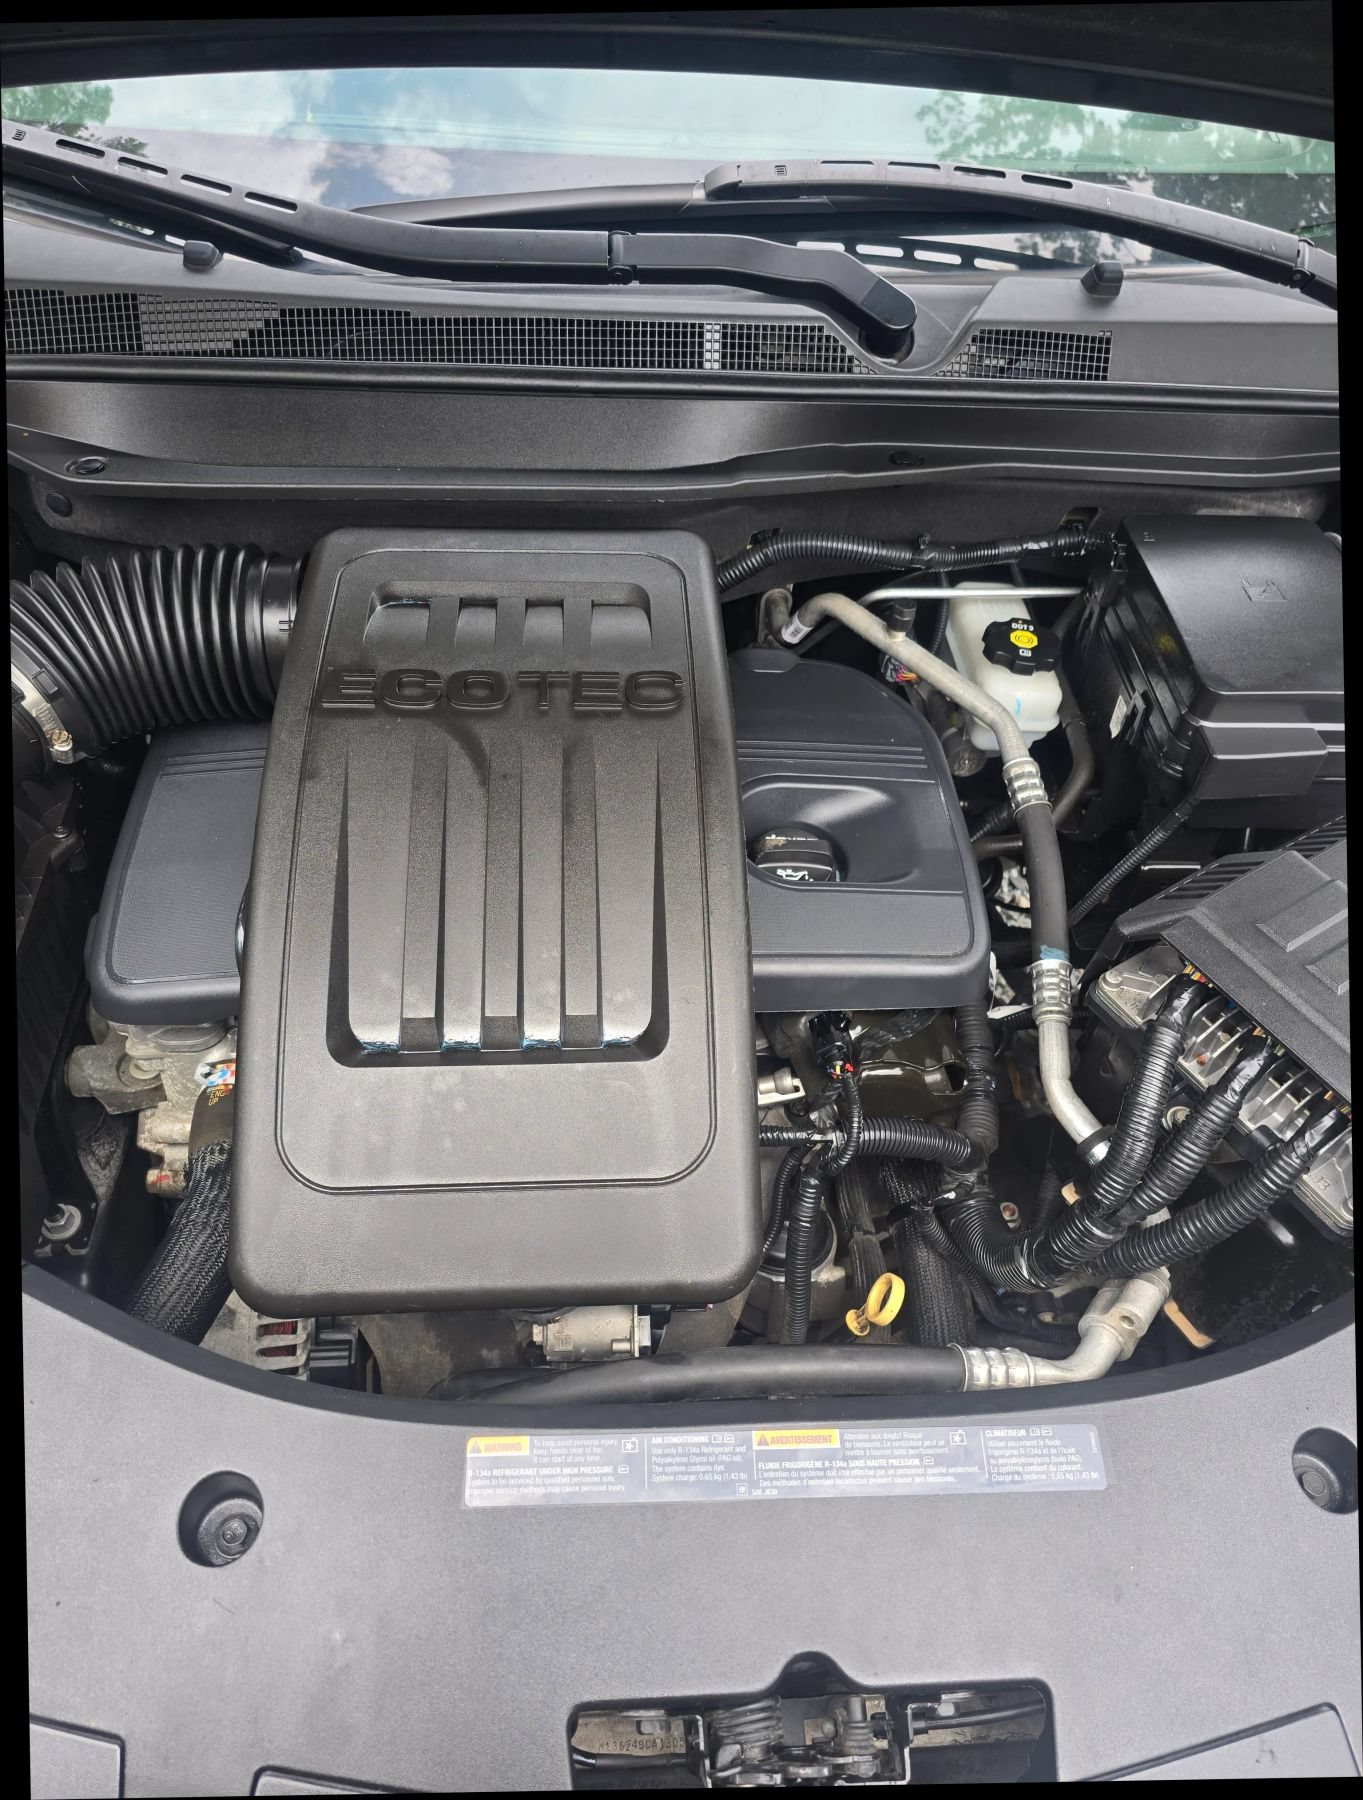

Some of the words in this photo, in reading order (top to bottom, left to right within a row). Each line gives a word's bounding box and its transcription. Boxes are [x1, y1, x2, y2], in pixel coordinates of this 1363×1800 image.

[1012, 622, 1028, 630] DOT
[320, 668, 684, 712] ECOTEC
[208, 1098, 218, 1106] UP
[574, 1439, 599, 1447] personal
[652, 1436, 663, 1444] AIR
[770, 1435, 832, 1444] AVERTISSEMENT
[484, 1442, 522, 1451] WARNING
[678, 1446, 700, 1454] R-134a
[701, 1446, 734, 1454] Refrigerant
[690, 1455, 707, 1463] Glycol
[824, 1460, 847, 1468] R-134a
[888, 1458, 920, 1466] PRESSION
[492, 1468, 538, 1476] REFRIGERANT
[580, 1466, 614, 1474] PRESSURE
[664, 1465, 686, 1473] system
[1024, 1464, 1048, 1472] contient
[714, 1473, 722, 1481] kg
[1066, 1472, 1074, 1480] kg
[581, 1484, 606, 1492] personal
